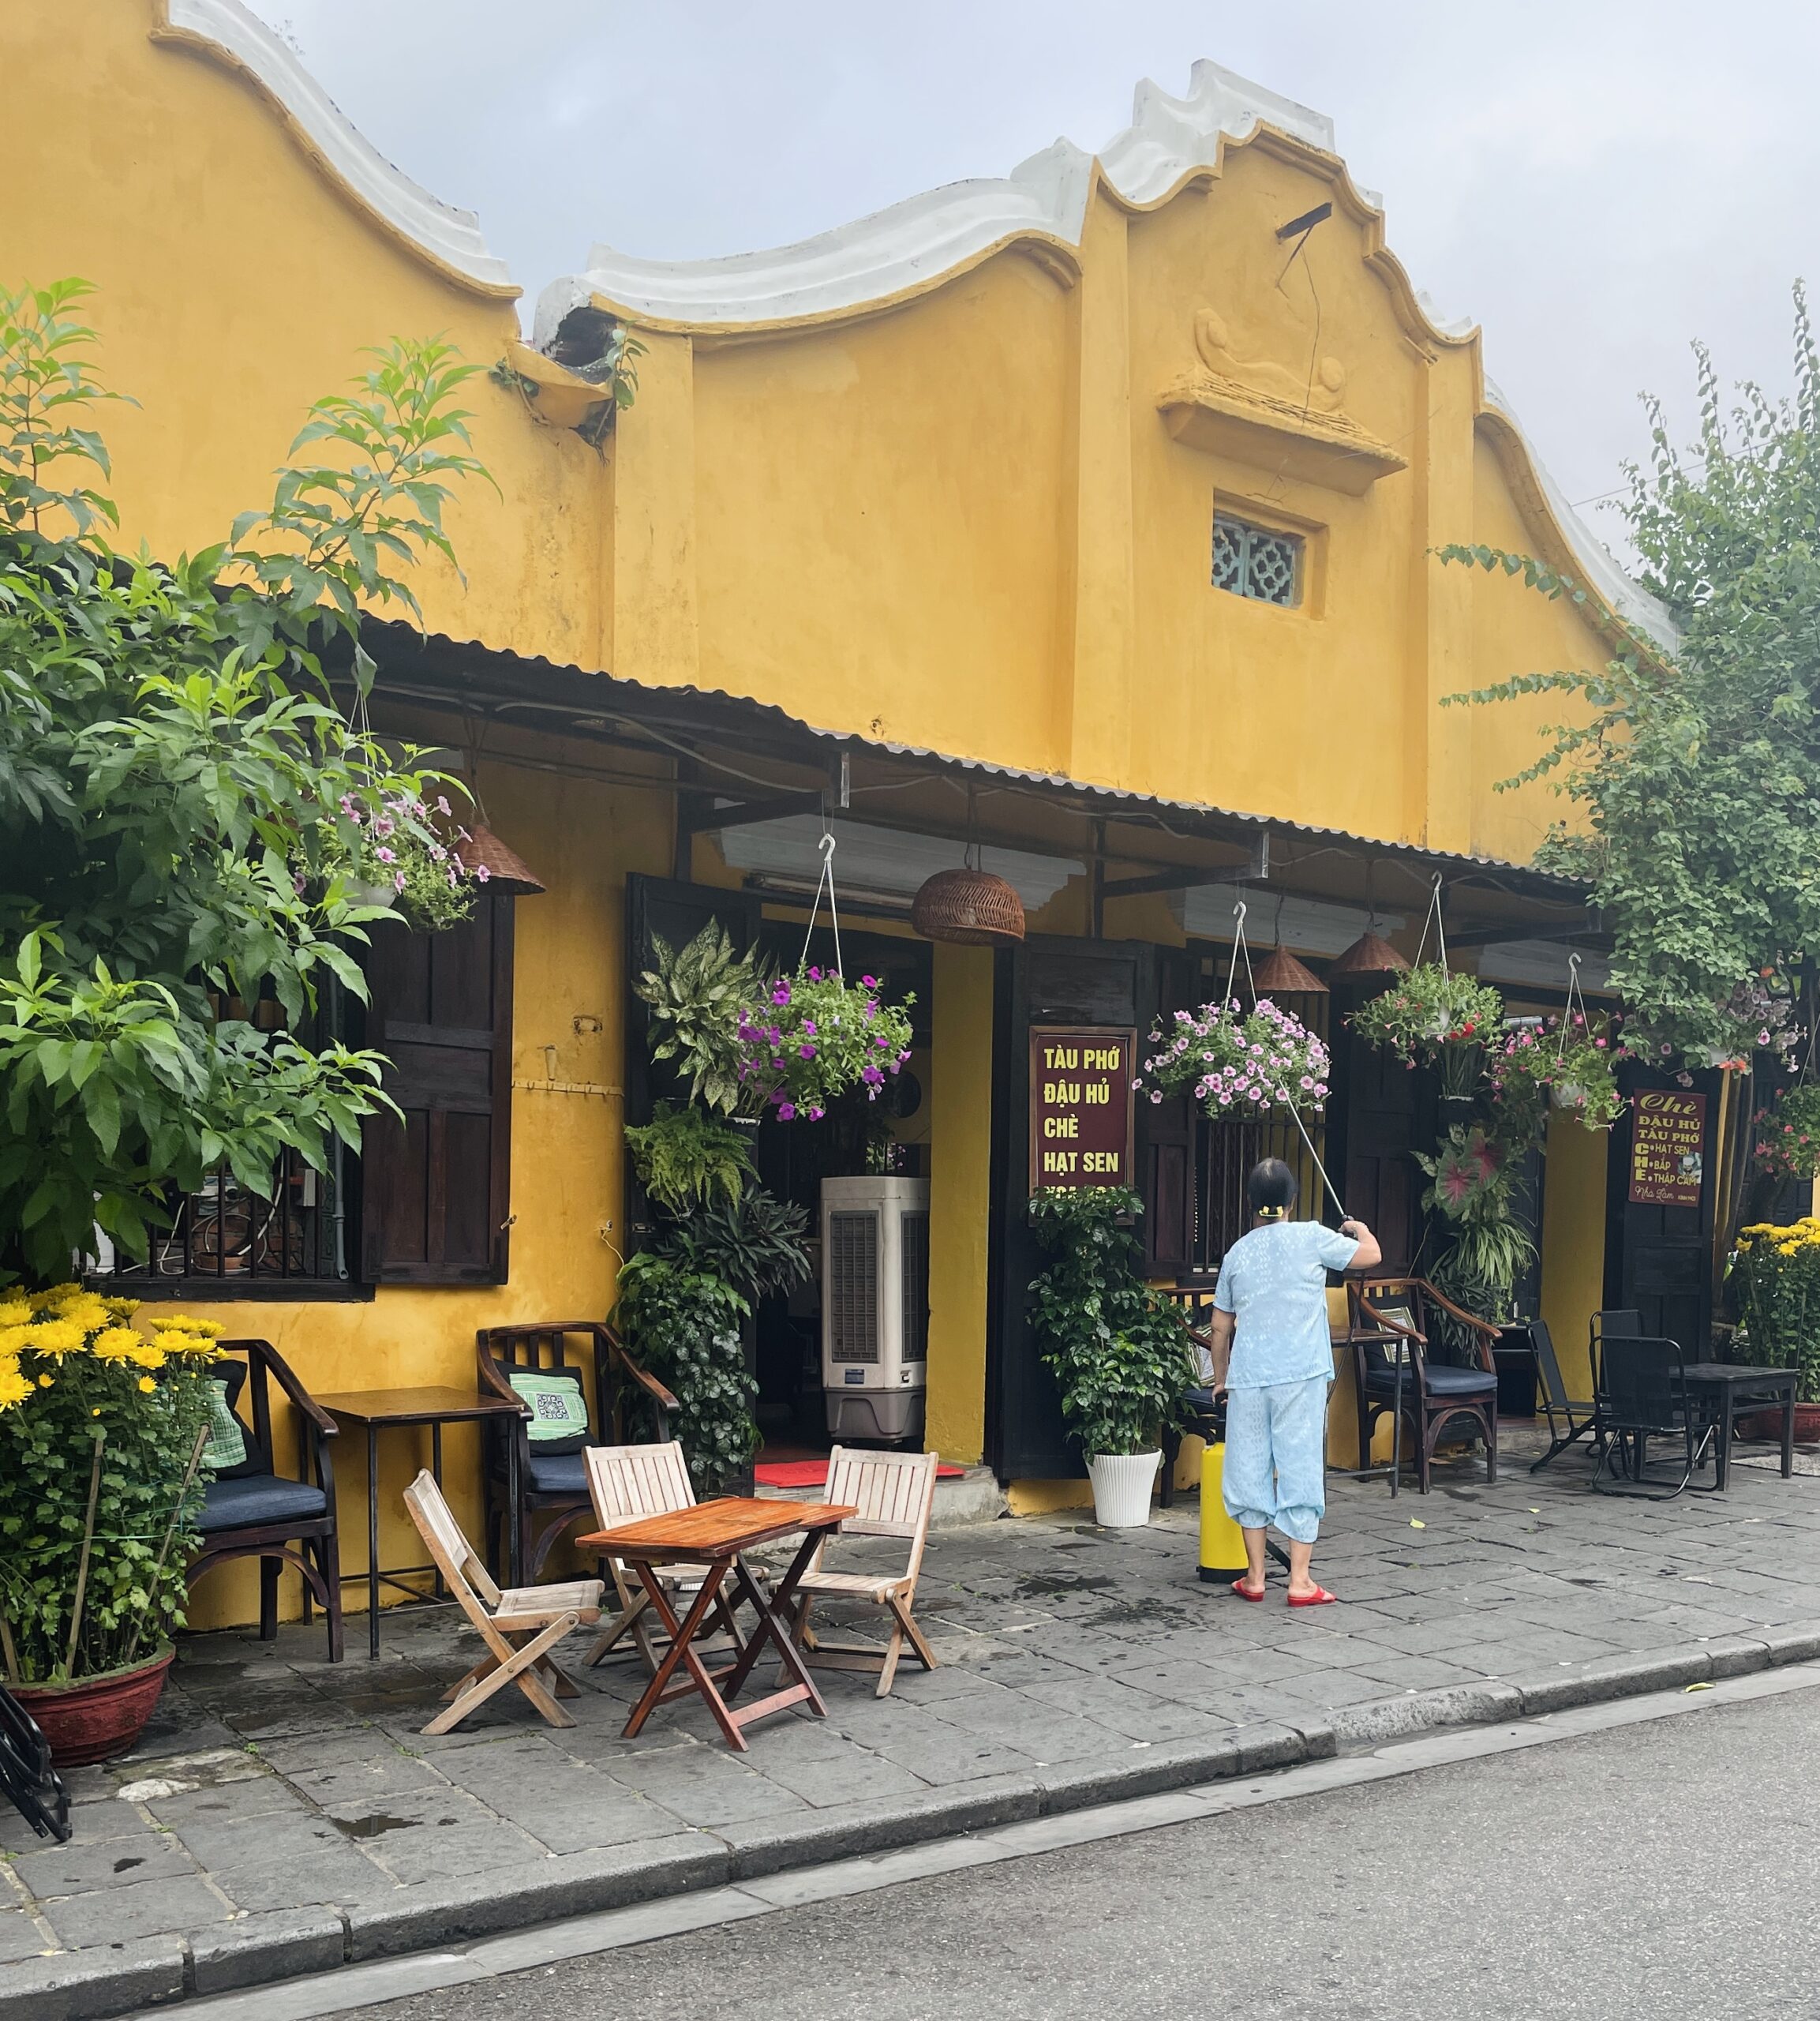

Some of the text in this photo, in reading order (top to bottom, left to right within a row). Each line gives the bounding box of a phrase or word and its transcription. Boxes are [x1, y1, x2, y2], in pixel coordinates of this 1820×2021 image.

[1043, 1044, 1121, 1070] TÀU PHỚ
[1043, 1077, 1110, 1108] ĐẬU HỦ
[1639, 1093, 1698, 1115] Chè
[1043, 1113, 1079, 1138] CHÈ
[1638, 1114, 1701, 1130] ĐẬU HỦ
[1638, 1127, 1668, 1141] TÀU
[1673, 1145, 1690, 1155] SEN
[1043, 1152, 1119, 1176] HẠT SEN
